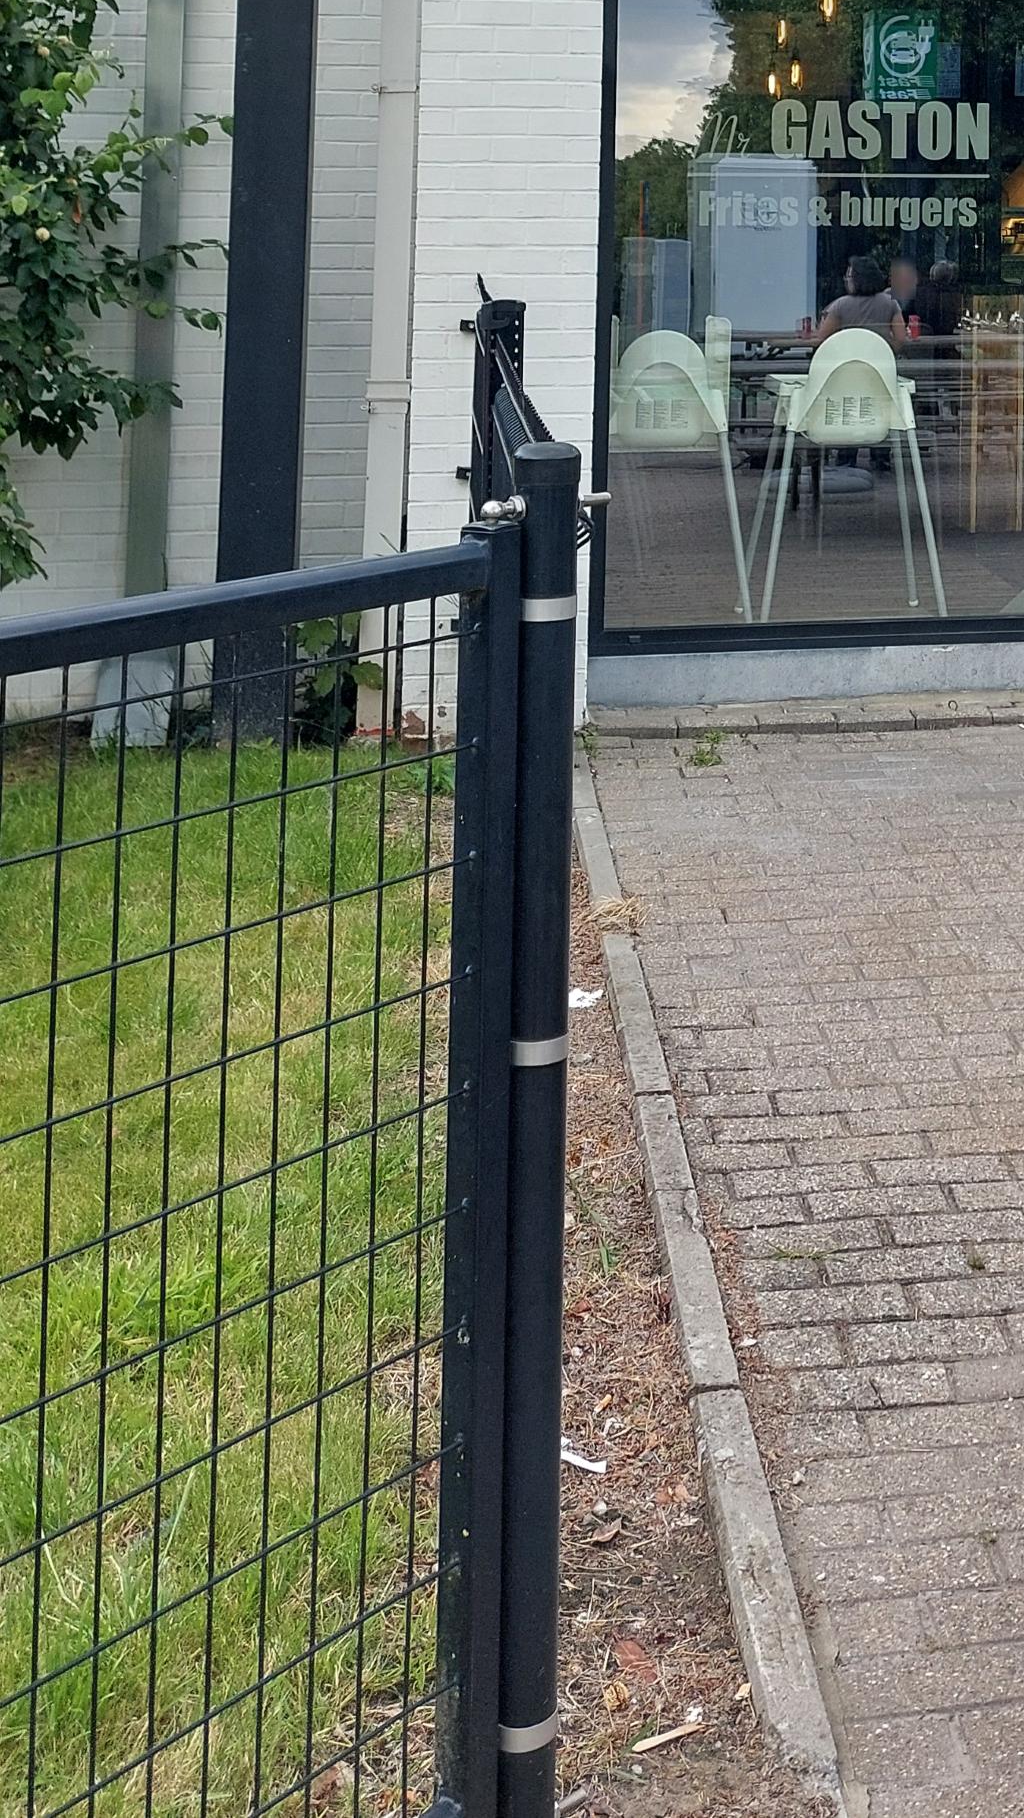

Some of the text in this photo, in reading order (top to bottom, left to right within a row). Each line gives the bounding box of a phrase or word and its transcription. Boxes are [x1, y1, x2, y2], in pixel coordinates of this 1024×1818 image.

[771, 99, 990, 160] GASTON
[699, 191, 978, 230] Frites & burgers
